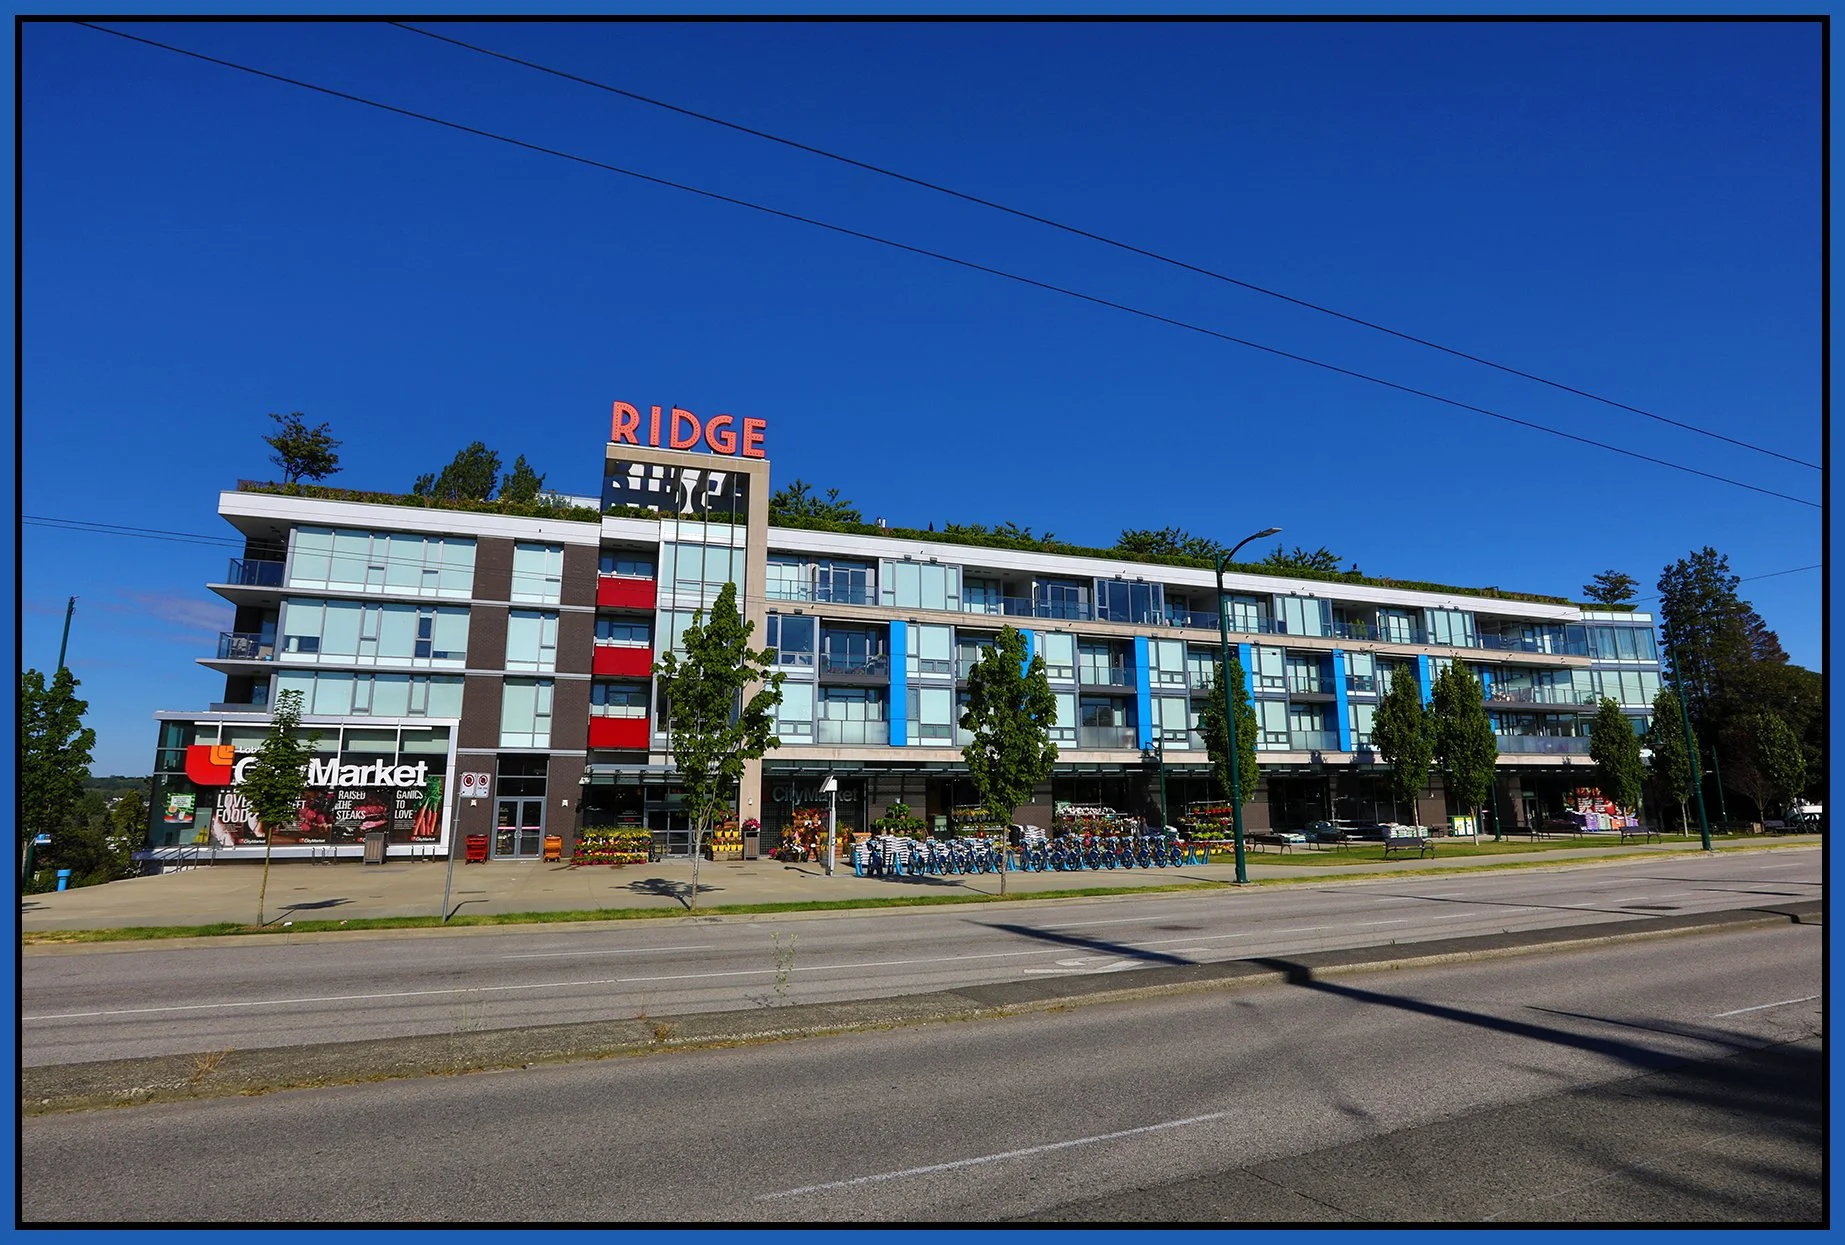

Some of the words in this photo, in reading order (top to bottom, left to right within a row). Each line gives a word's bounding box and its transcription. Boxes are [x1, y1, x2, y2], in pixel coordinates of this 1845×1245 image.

[611, 400, 767, 458] RIDGE
[338, 790, 366, 800] RAISED
[772, 786, 859, 806] CityMaket
[337, 800, 353, 810] THE
[396, 800, 406, 809] TO
[336, 810, 367, 820] STEAKS
[394, 810, 414, 819] LOVE
